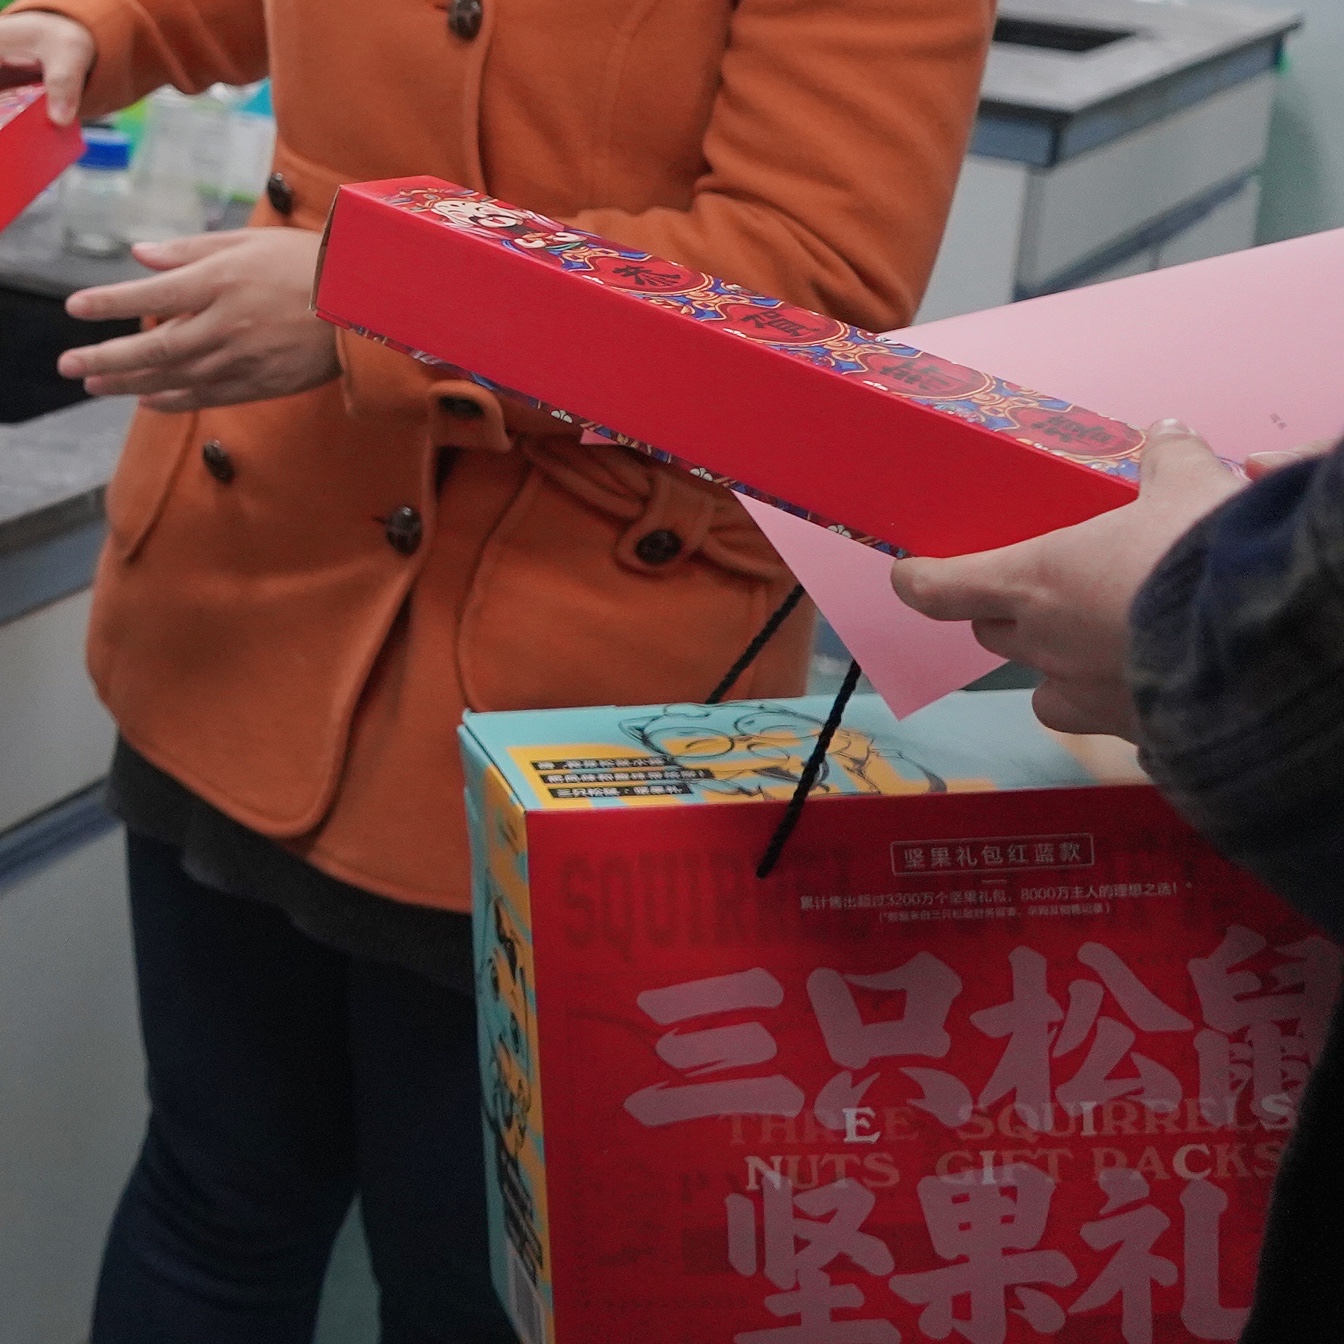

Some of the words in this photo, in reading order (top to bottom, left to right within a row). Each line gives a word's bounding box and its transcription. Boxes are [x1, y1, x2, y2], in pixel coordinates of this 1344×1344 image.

[903, 842, 1082, 869] 坚果礼包红蓝款
[622, 923, 1340, 1132] 三只松鼠
[744, 1153, 904, 1195] NUTS
[934, 1147, 1075, 1188] GIFT
[725, 1163, 1255, 1344] 坚果礼
